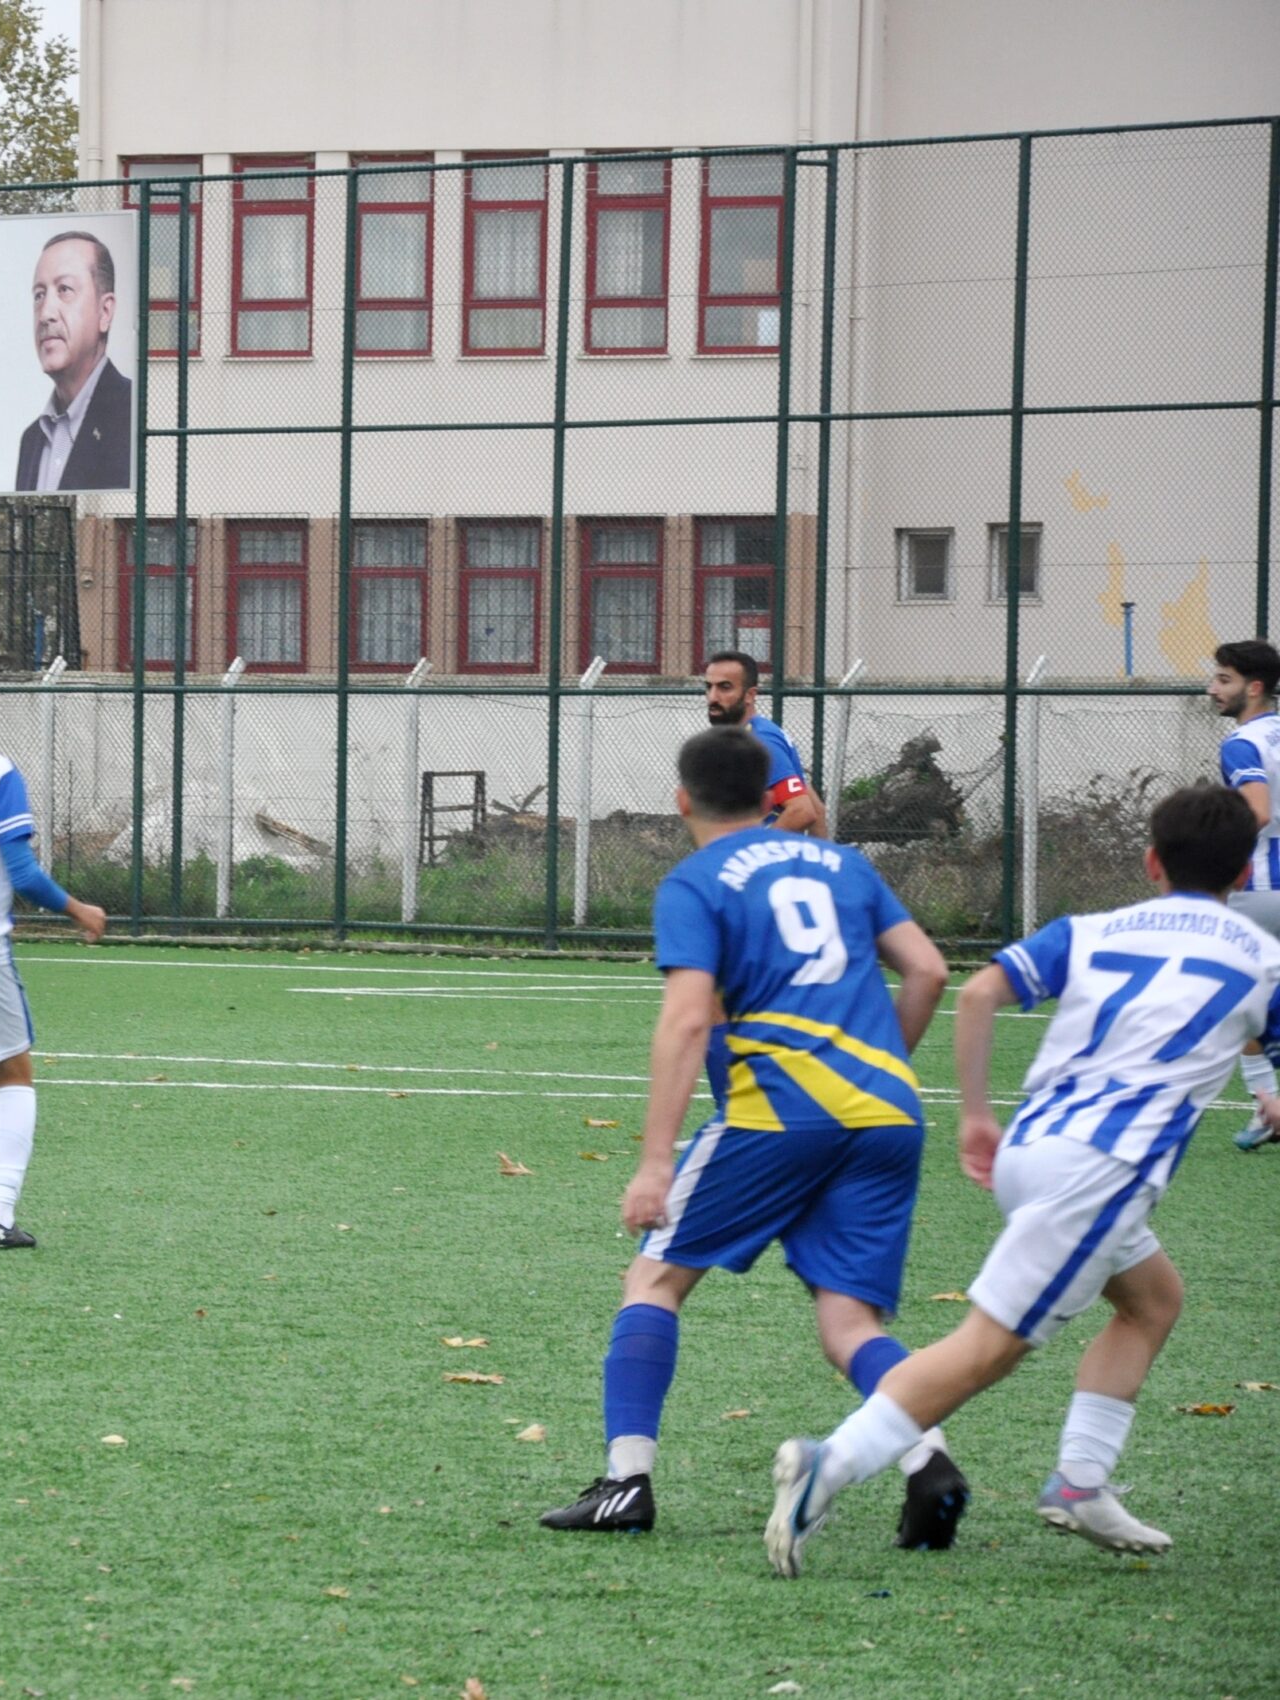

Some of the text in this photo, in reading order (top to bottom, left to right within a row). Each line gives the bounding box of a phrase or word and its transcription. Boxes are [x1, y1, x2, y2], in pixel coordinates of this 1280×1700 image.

[788, 778, 802, 793] C
[768, 877, 848, 985] 9
[1073, 951, 1257, 1063] 77
